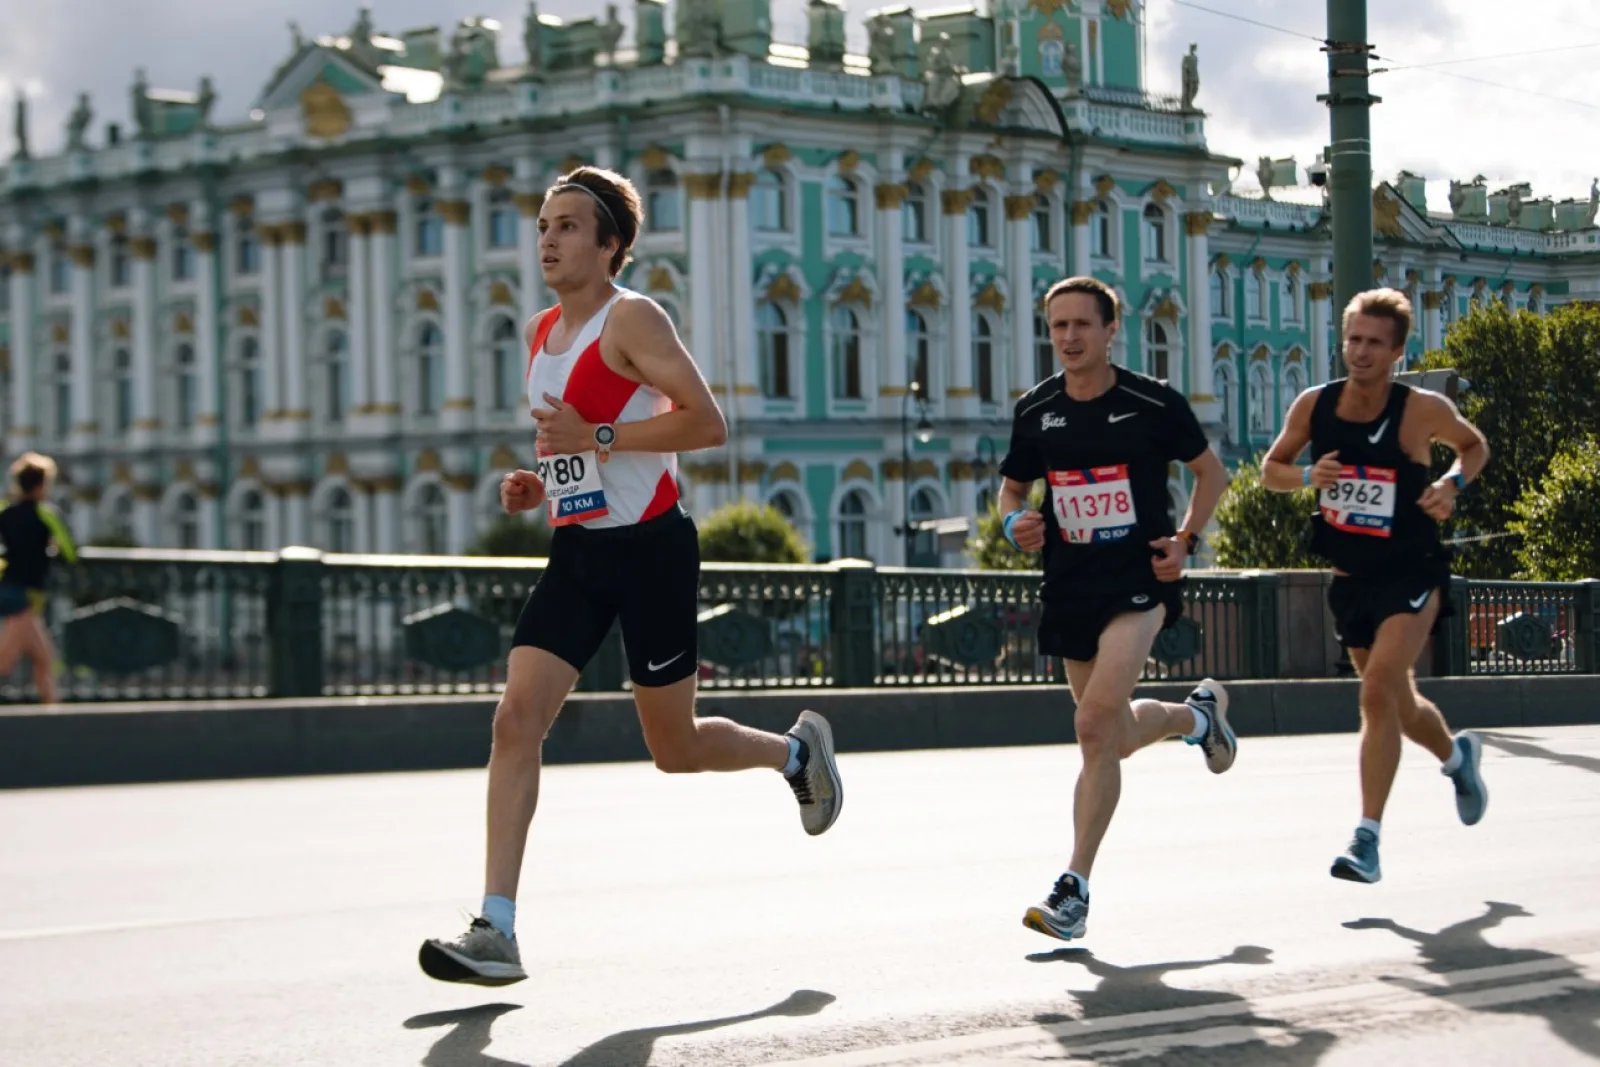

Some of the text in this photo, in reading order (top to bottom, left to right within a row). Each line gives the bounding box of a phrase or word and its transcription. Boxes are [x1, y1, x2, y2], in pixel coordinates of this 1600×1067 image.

[1327, 481, 1384, 506] 8962
[562, 497, 594, 512] 10 KM
[1057, 490, 1131, 519] 11378
[1353, 516, 1366, 525] 10
[1099, 530, 1111, 540] 10
